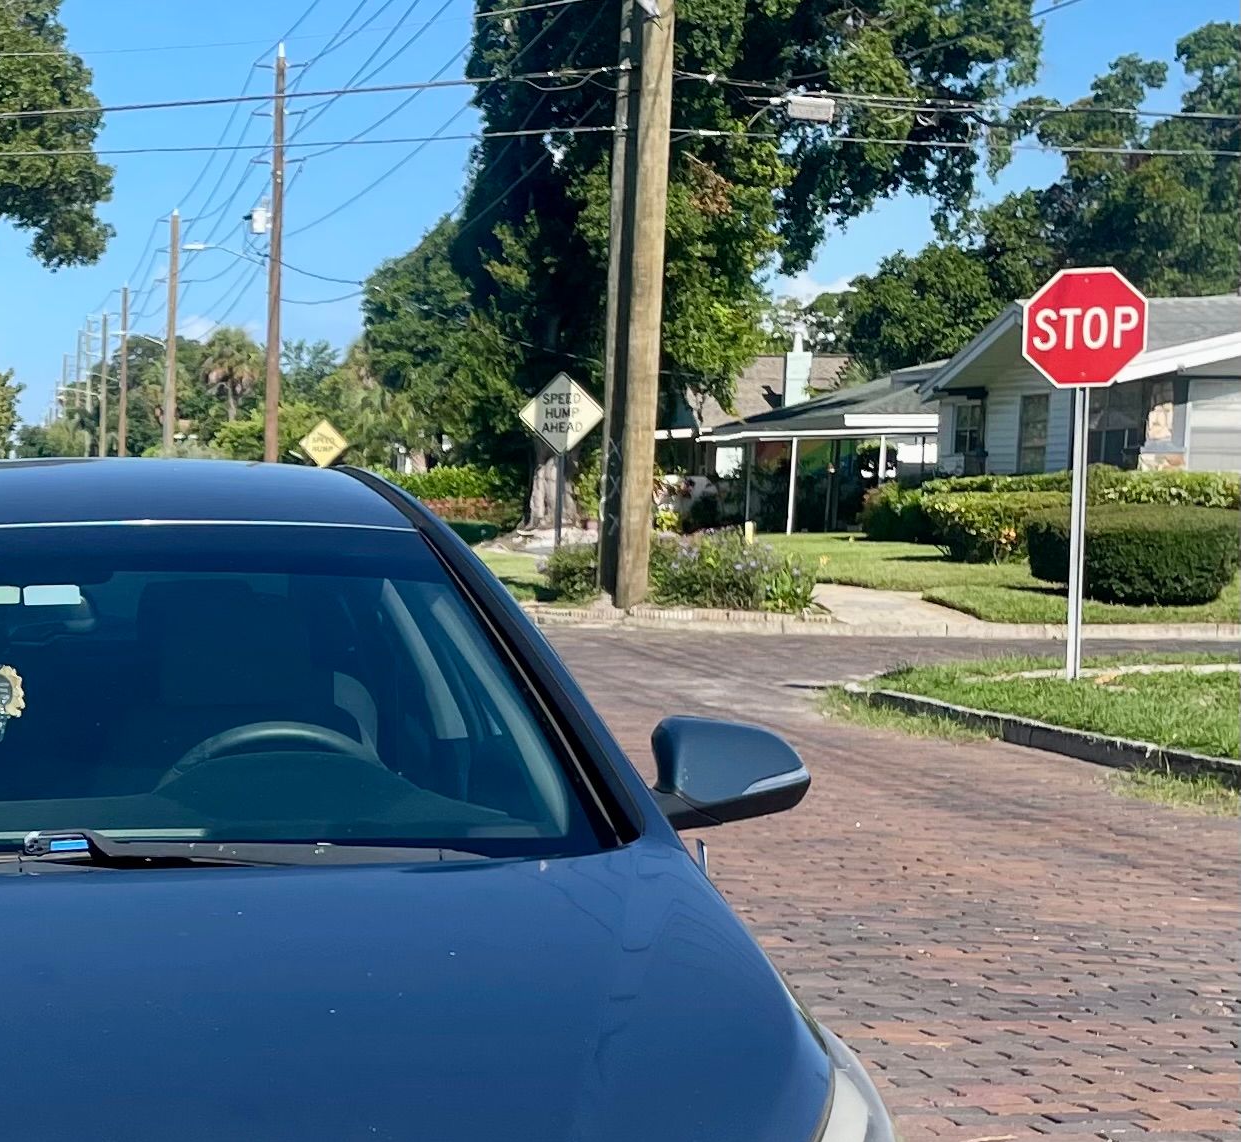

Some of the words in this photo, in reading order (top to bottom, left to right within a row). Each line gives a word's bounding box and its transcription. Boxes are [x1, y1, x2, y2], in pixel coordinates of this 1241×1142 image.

[1032, 306, 1139, 351] STOP
[542, 392, 581, 405] SPEED
[541, 421, 583, 433] AHEAD
